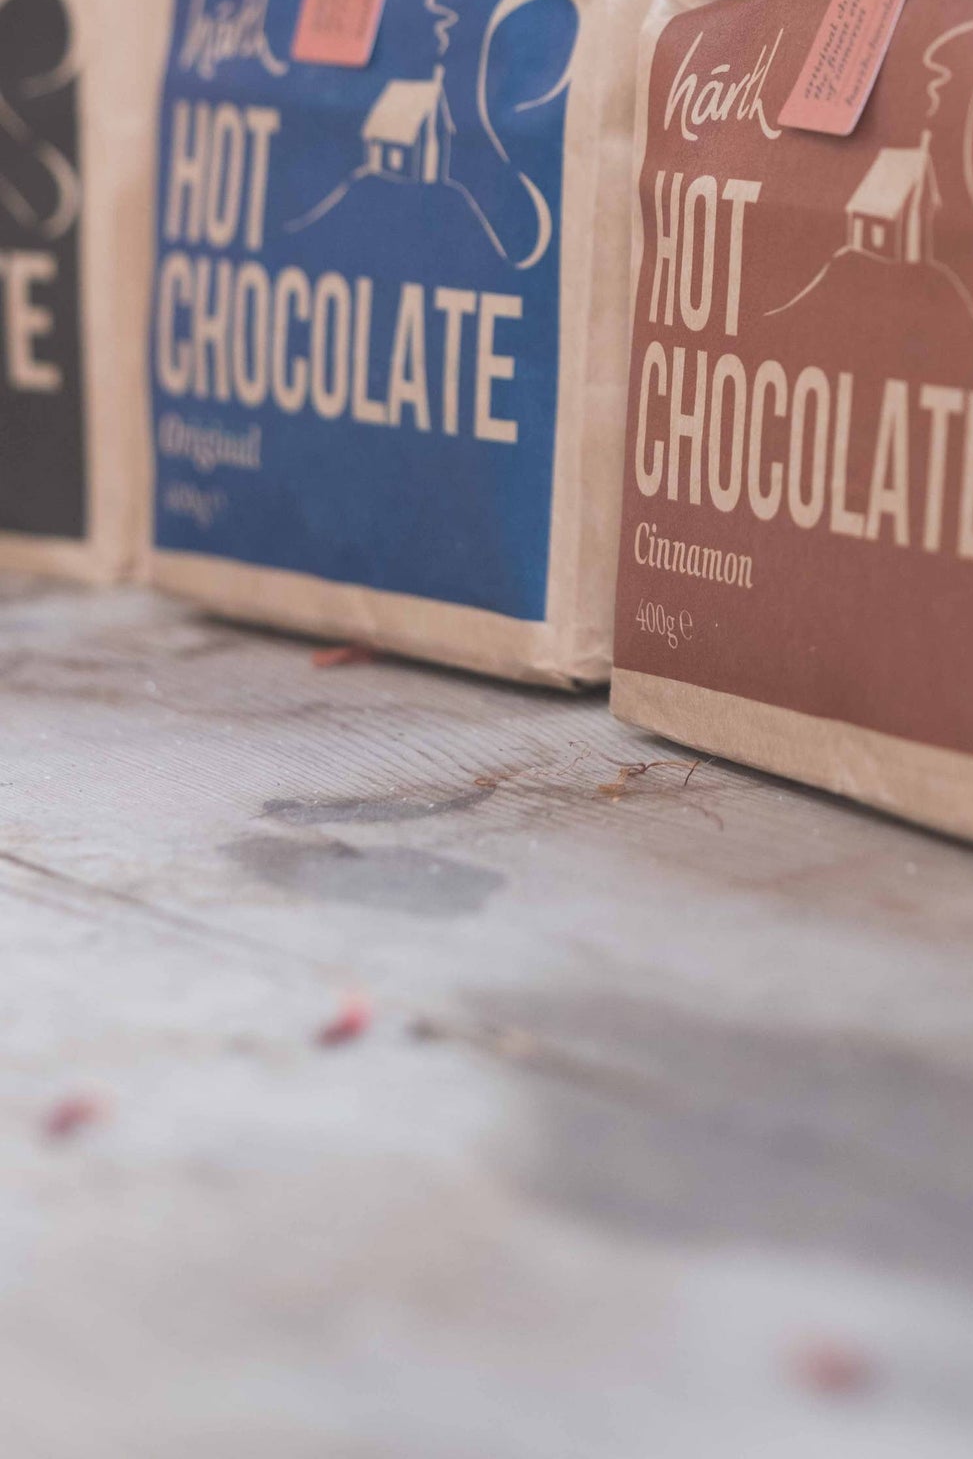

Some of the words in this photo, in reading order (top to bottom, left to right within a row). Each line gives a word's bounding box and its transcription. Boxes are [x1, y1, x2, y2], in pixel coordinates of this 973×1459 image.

[164, 99, 280, 251] HOT
[0, 253, 61, 392] E
[649, 169, 763, 337] HOT
[156, 251, 523, 445] CHOCOLATE
[634, 522, 753, 588] Cinnamon
